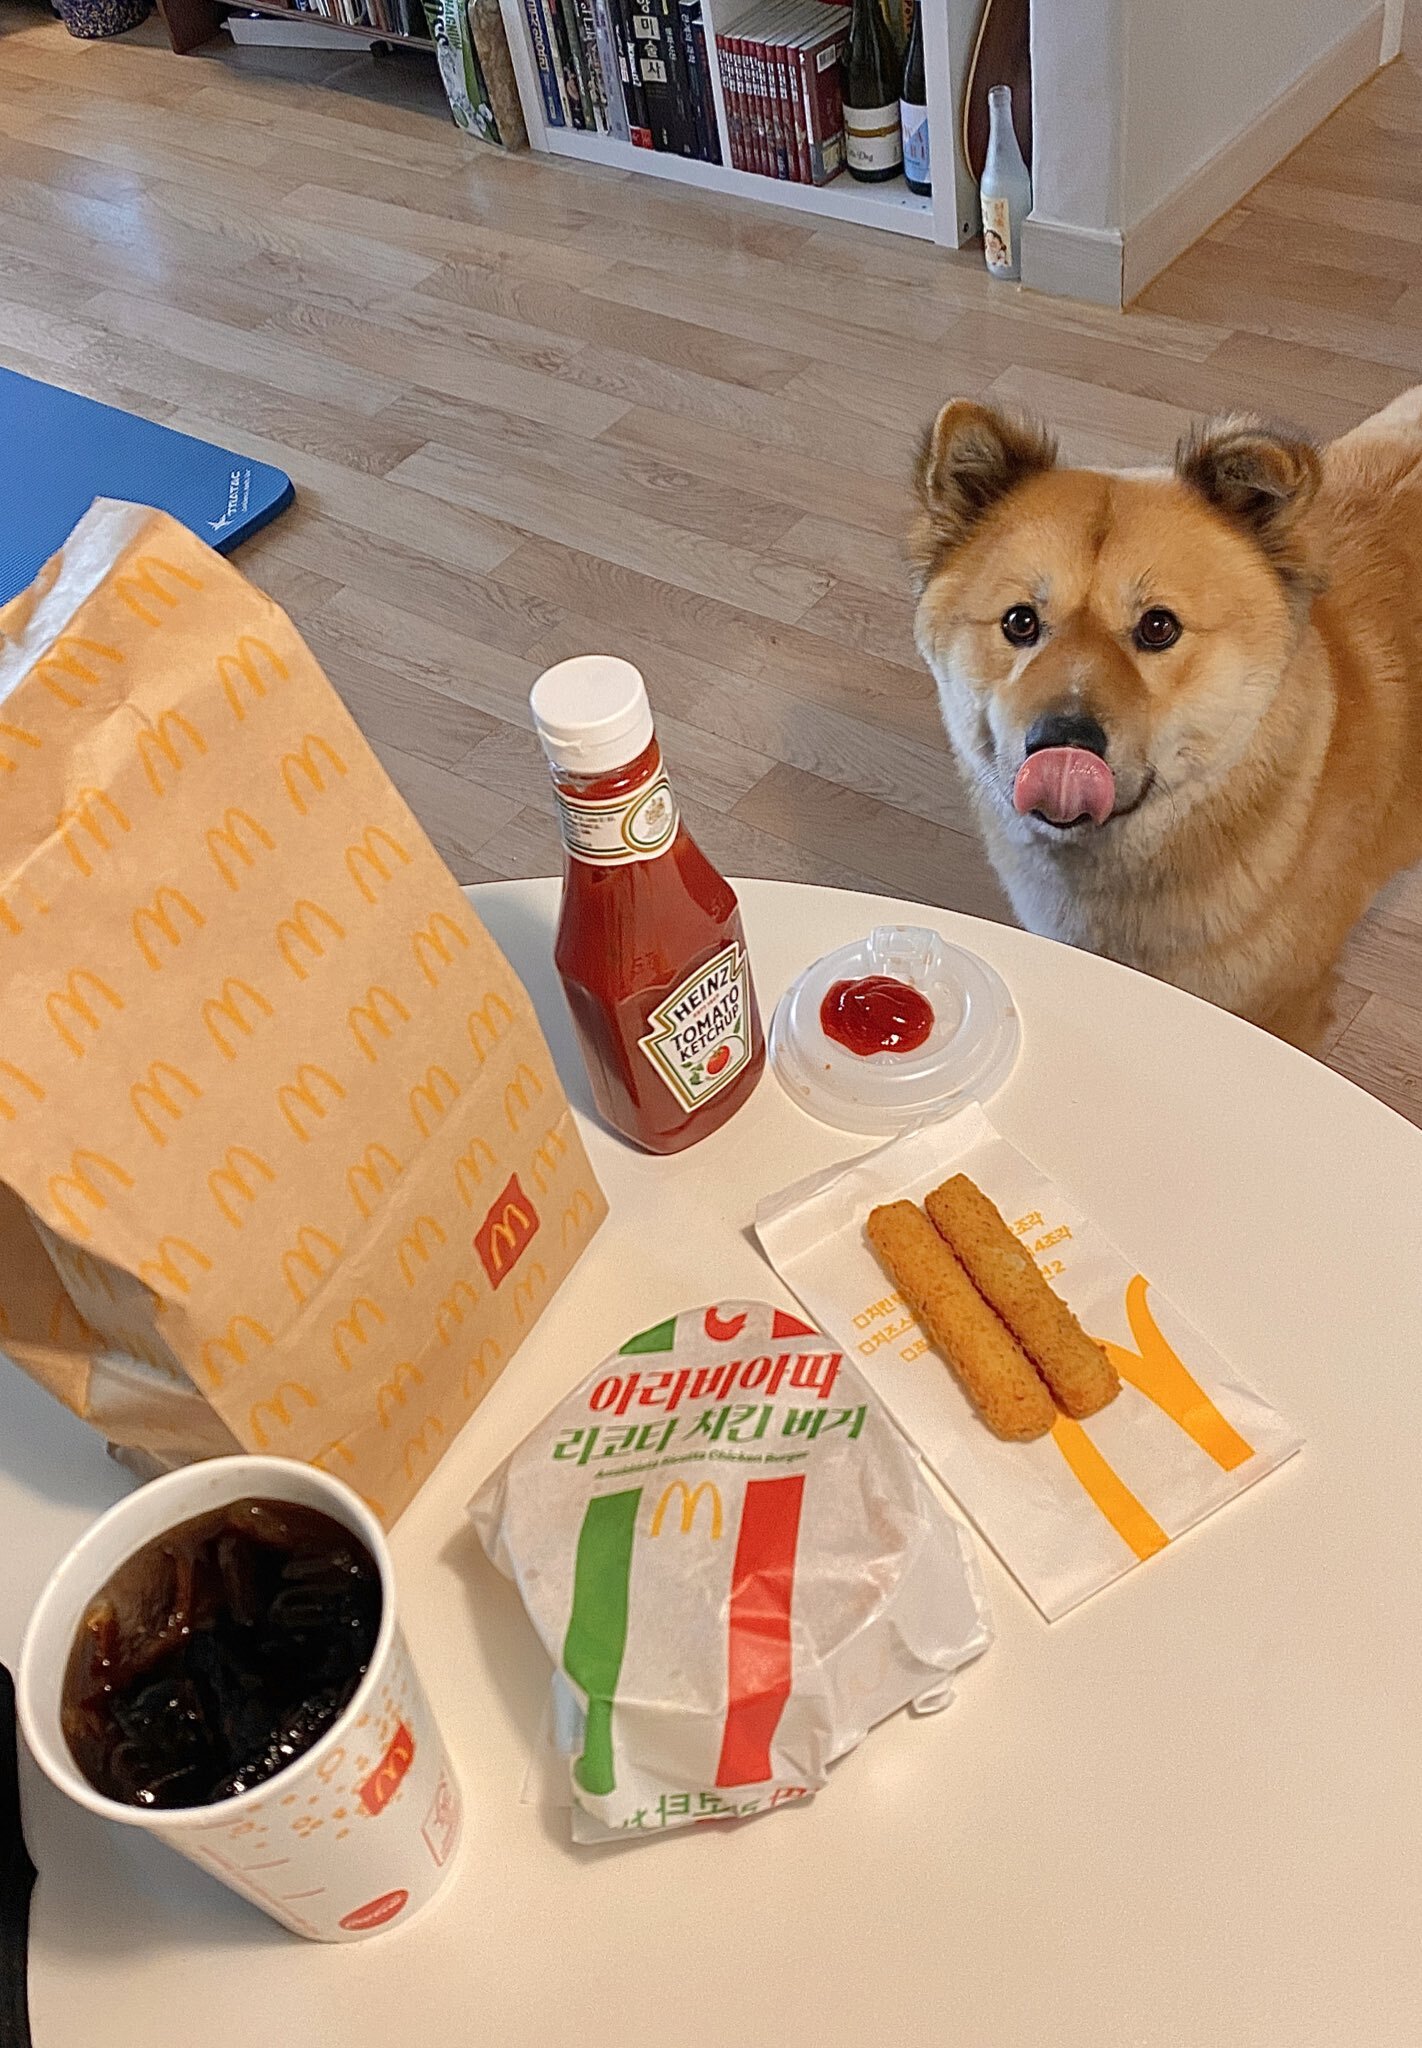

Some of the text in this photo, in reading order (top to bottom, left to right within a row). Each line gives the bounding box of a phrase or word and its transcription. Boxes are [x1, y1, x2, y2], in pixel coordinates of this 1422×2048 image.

[670, 985, 739, 1051] TOMATO
[674, 965, 729, 1022] HEINZ
[680, 1005, 739, 1062] KETCHUP
[588, 1352, 843, 1417] 아라비아따
[552, 1403, 868, 1465] 리코타 치킨 버거
